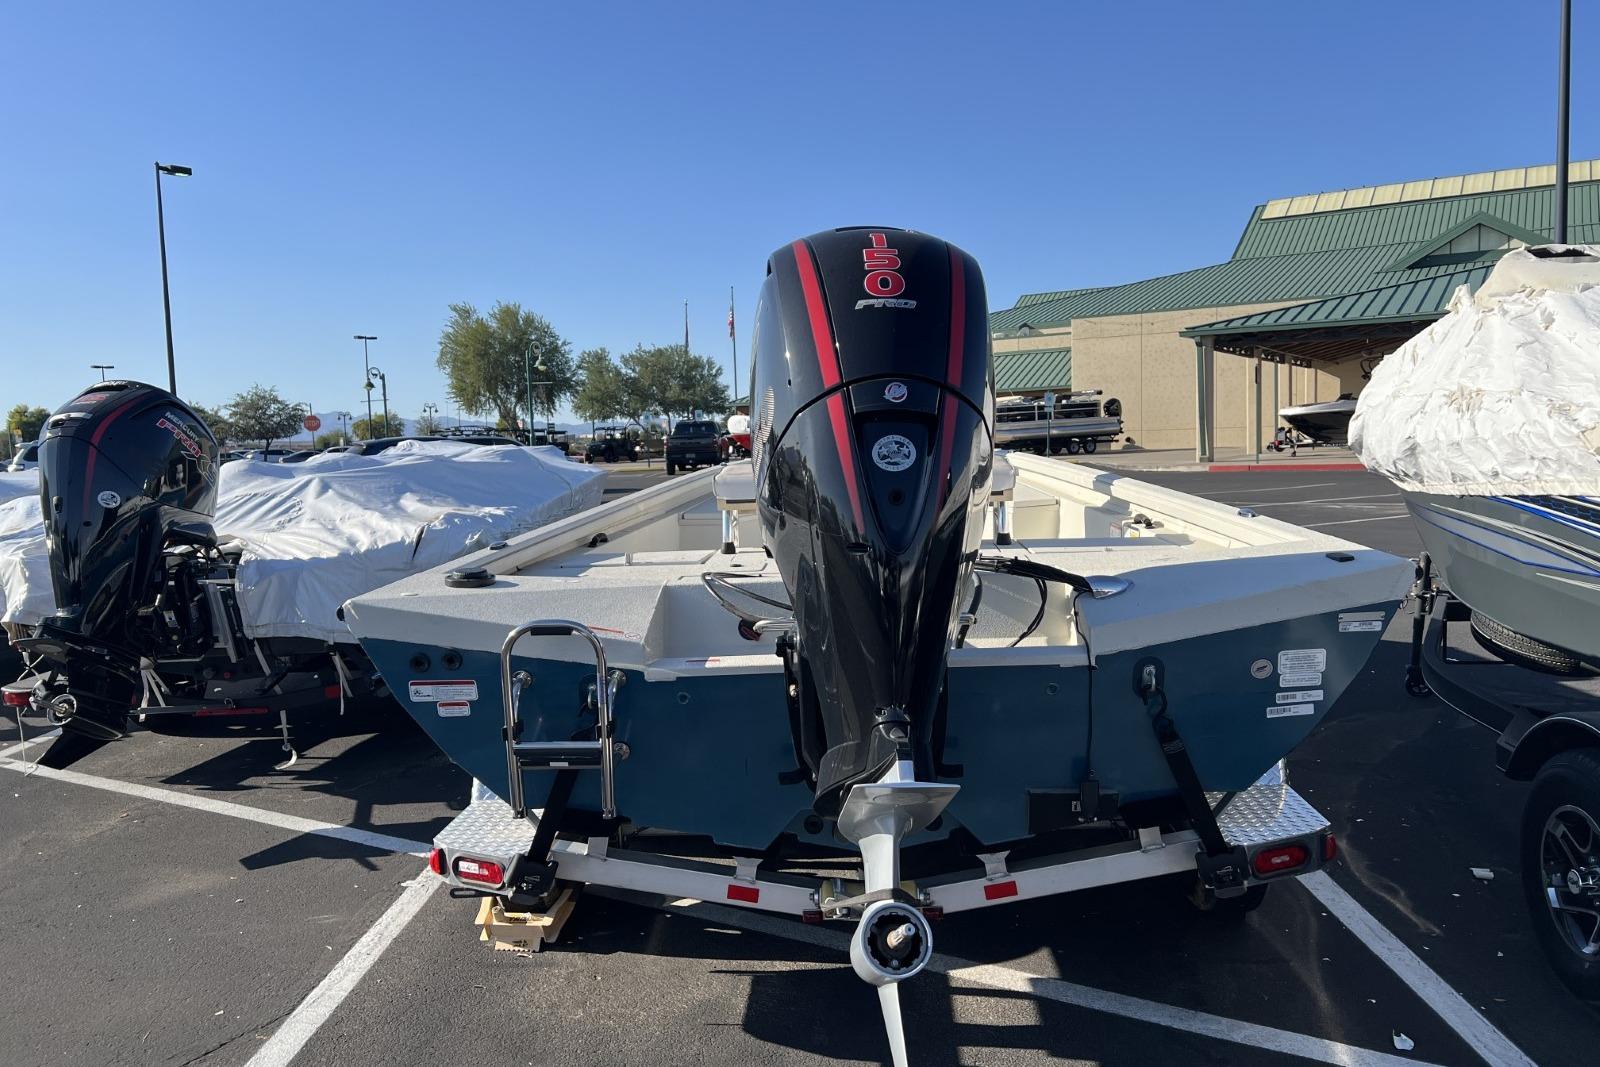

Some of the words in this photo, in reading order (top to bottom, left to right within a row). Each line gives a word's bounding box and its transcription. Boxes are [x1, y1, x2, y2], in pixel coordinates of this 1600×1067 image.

[863, 233, 905, 296] 150
[855, 299, 917, 310] PRO
[165, 411, 200, 441] MERCURY
